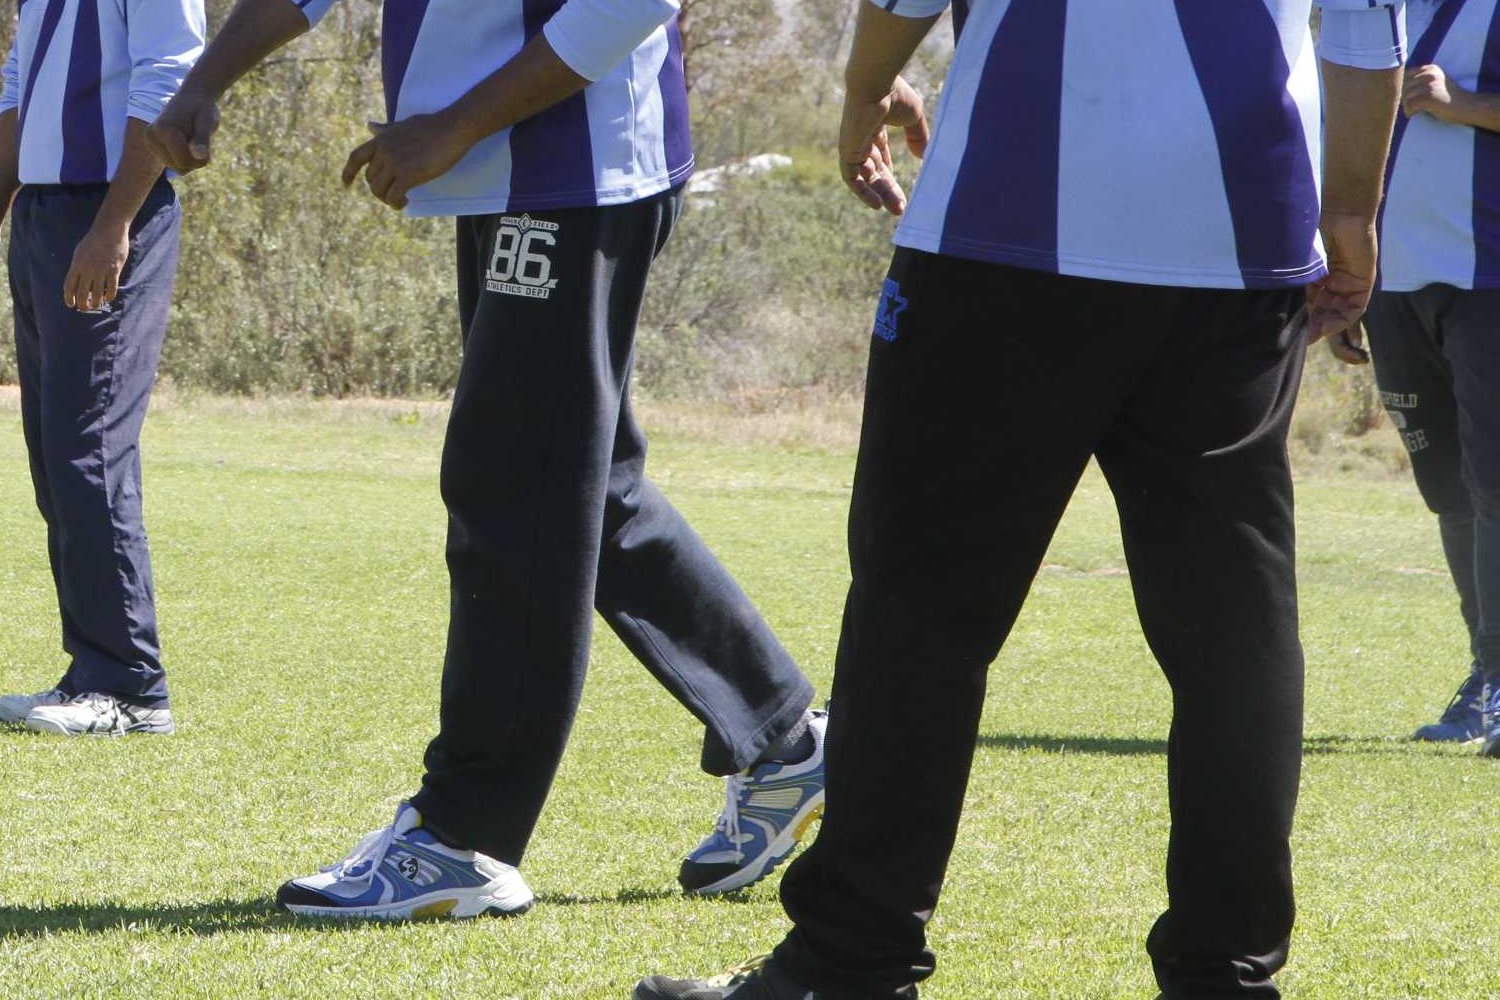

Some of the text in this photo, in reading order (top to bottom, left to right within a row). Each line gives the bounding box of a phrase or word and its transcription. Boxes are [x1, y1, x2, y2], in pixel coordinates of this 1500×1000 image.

[490, 225, 557, 287] 86
[486, 280, 549, 298] ATHLETICS DEPT
